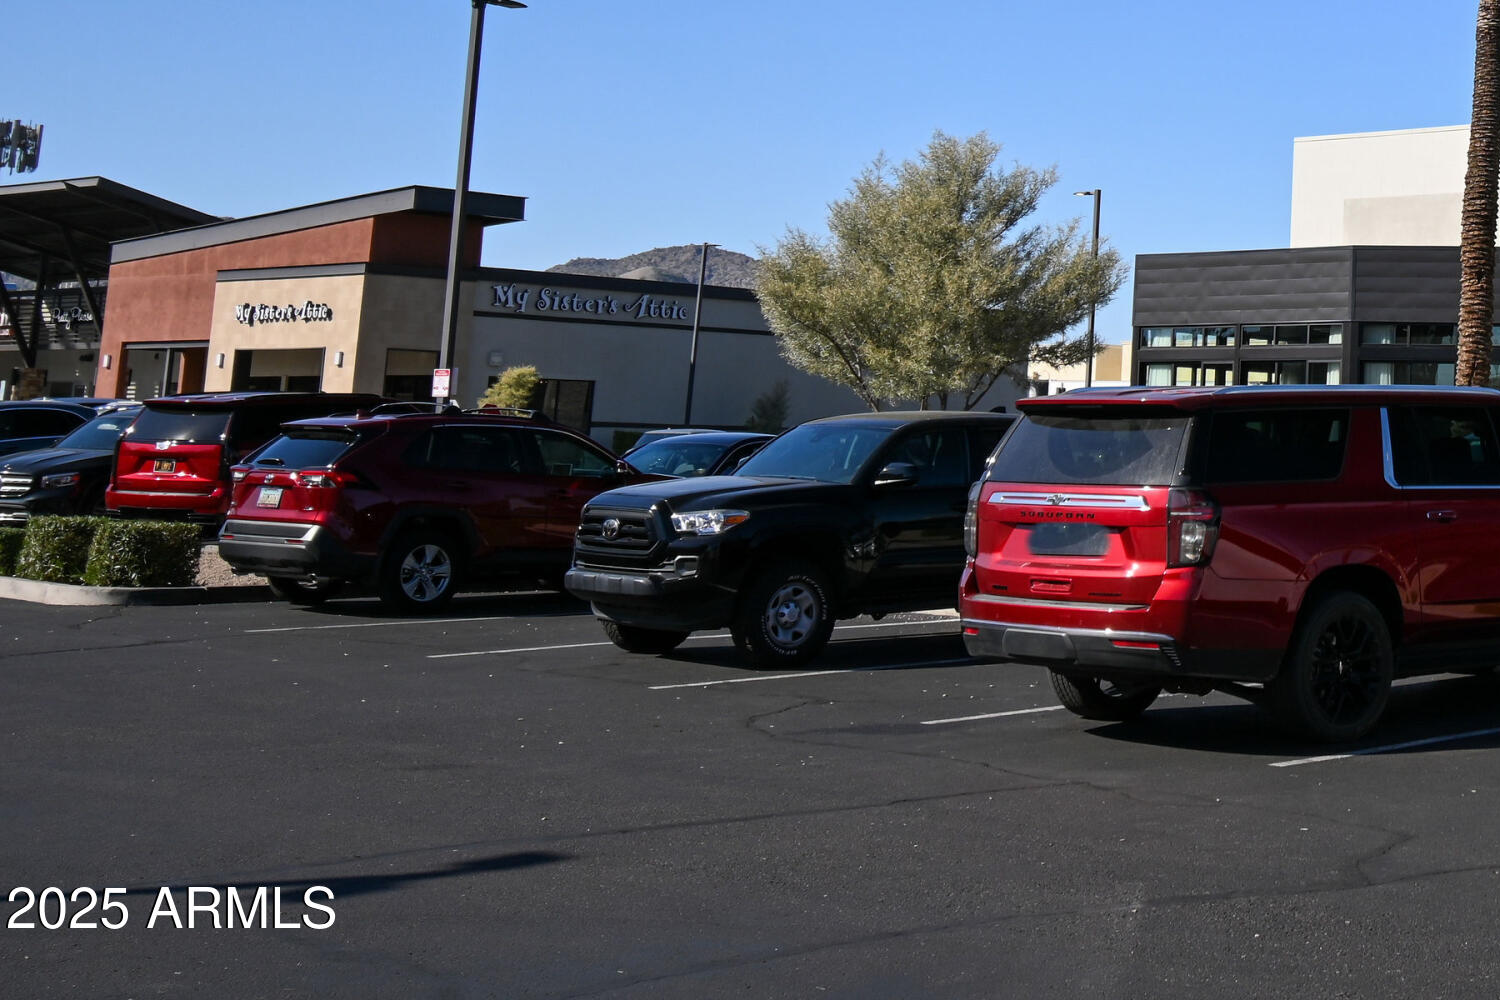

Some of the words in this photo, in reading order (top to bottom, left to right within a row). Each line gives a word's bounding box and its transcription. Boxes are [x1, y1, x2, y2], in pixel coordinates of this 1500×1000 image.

[235, 303, 253, 325] My
[294, 301, 333, 322] Attic
[493, 283, 532, 313] My
[536, 287, 618, 315] Sister's
[623, 294, 689, 319] Attic
